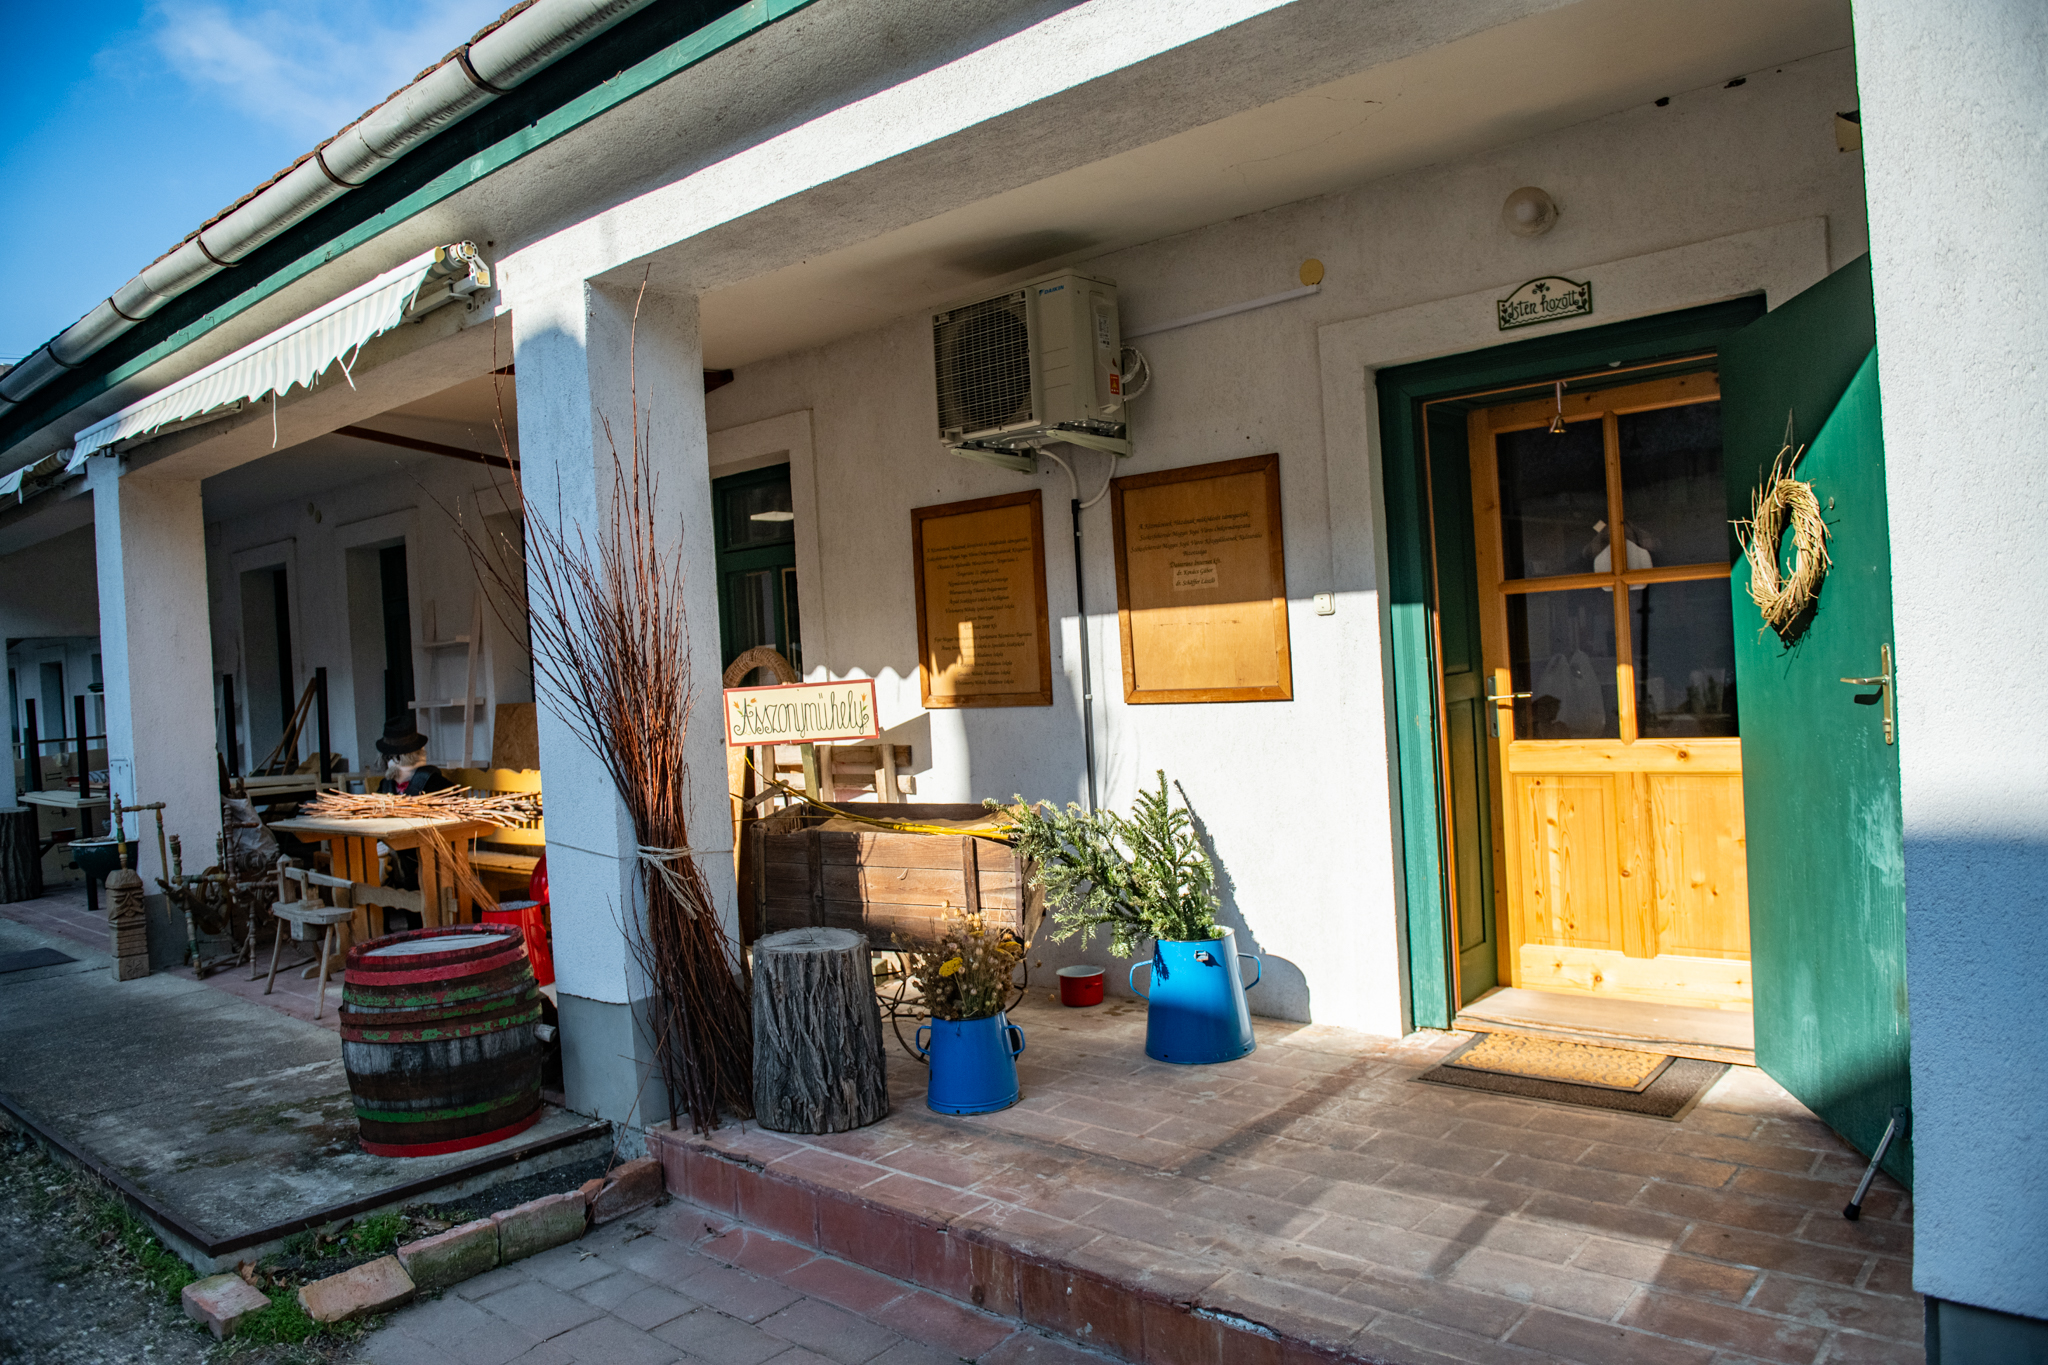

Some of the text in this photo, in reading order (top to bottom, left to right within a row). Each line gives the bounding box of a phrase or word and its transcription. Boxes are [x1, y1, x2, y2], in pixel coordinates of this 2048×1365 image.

[1044, 285, 1065, 295] DAIKIN
[1508, 290, 1579, 320] Isten hozott
